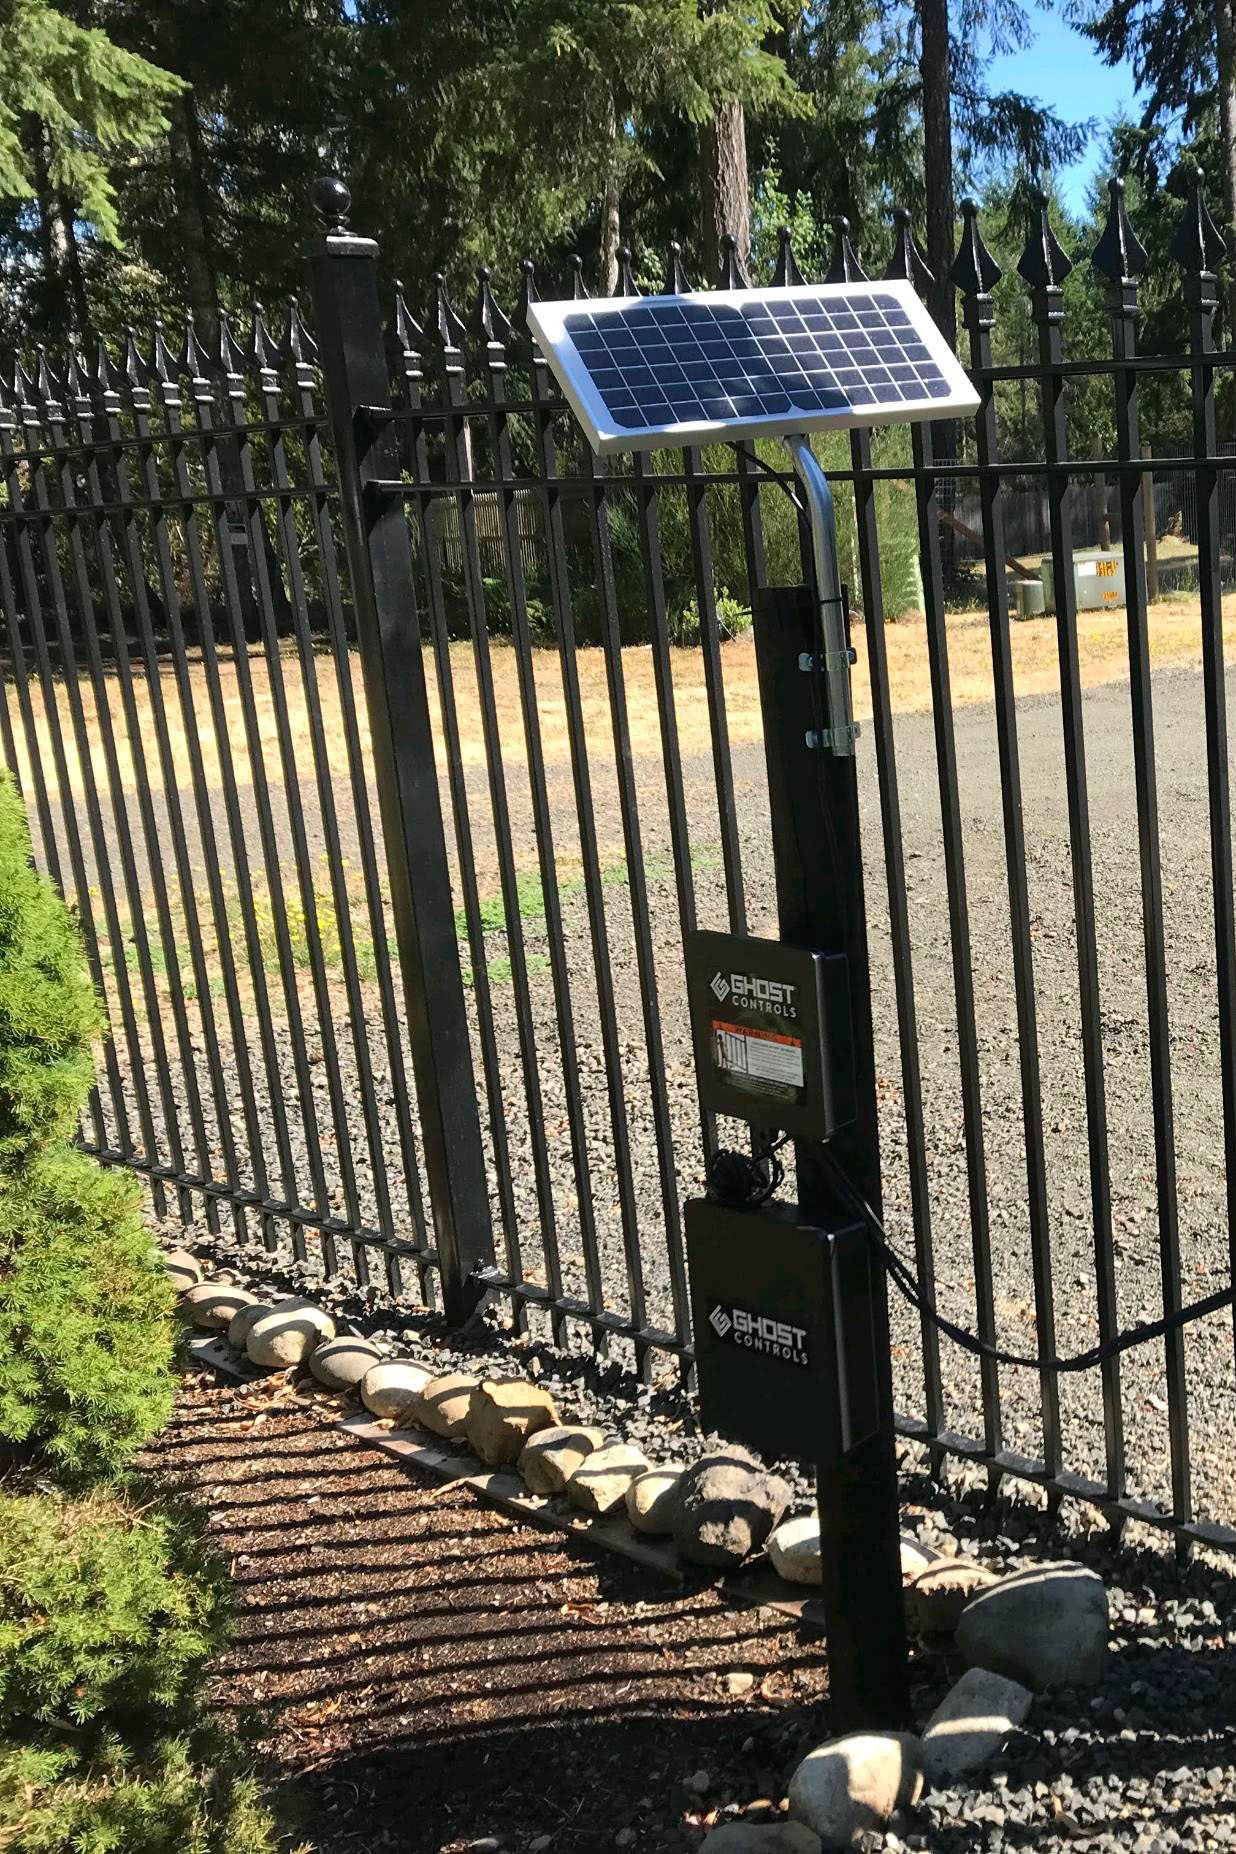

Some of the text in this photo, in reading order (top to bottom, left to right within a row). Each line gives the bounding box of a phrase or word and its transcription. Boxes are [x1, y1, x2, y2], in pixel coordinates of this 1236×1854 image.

[730, 973, 796, 1004] GHOST
[732, 995, 797, 1018] CONTROLS
[732, 1308, 807, 1349] GHOST
[734, 1333, 809, 1365] CONTROLS
